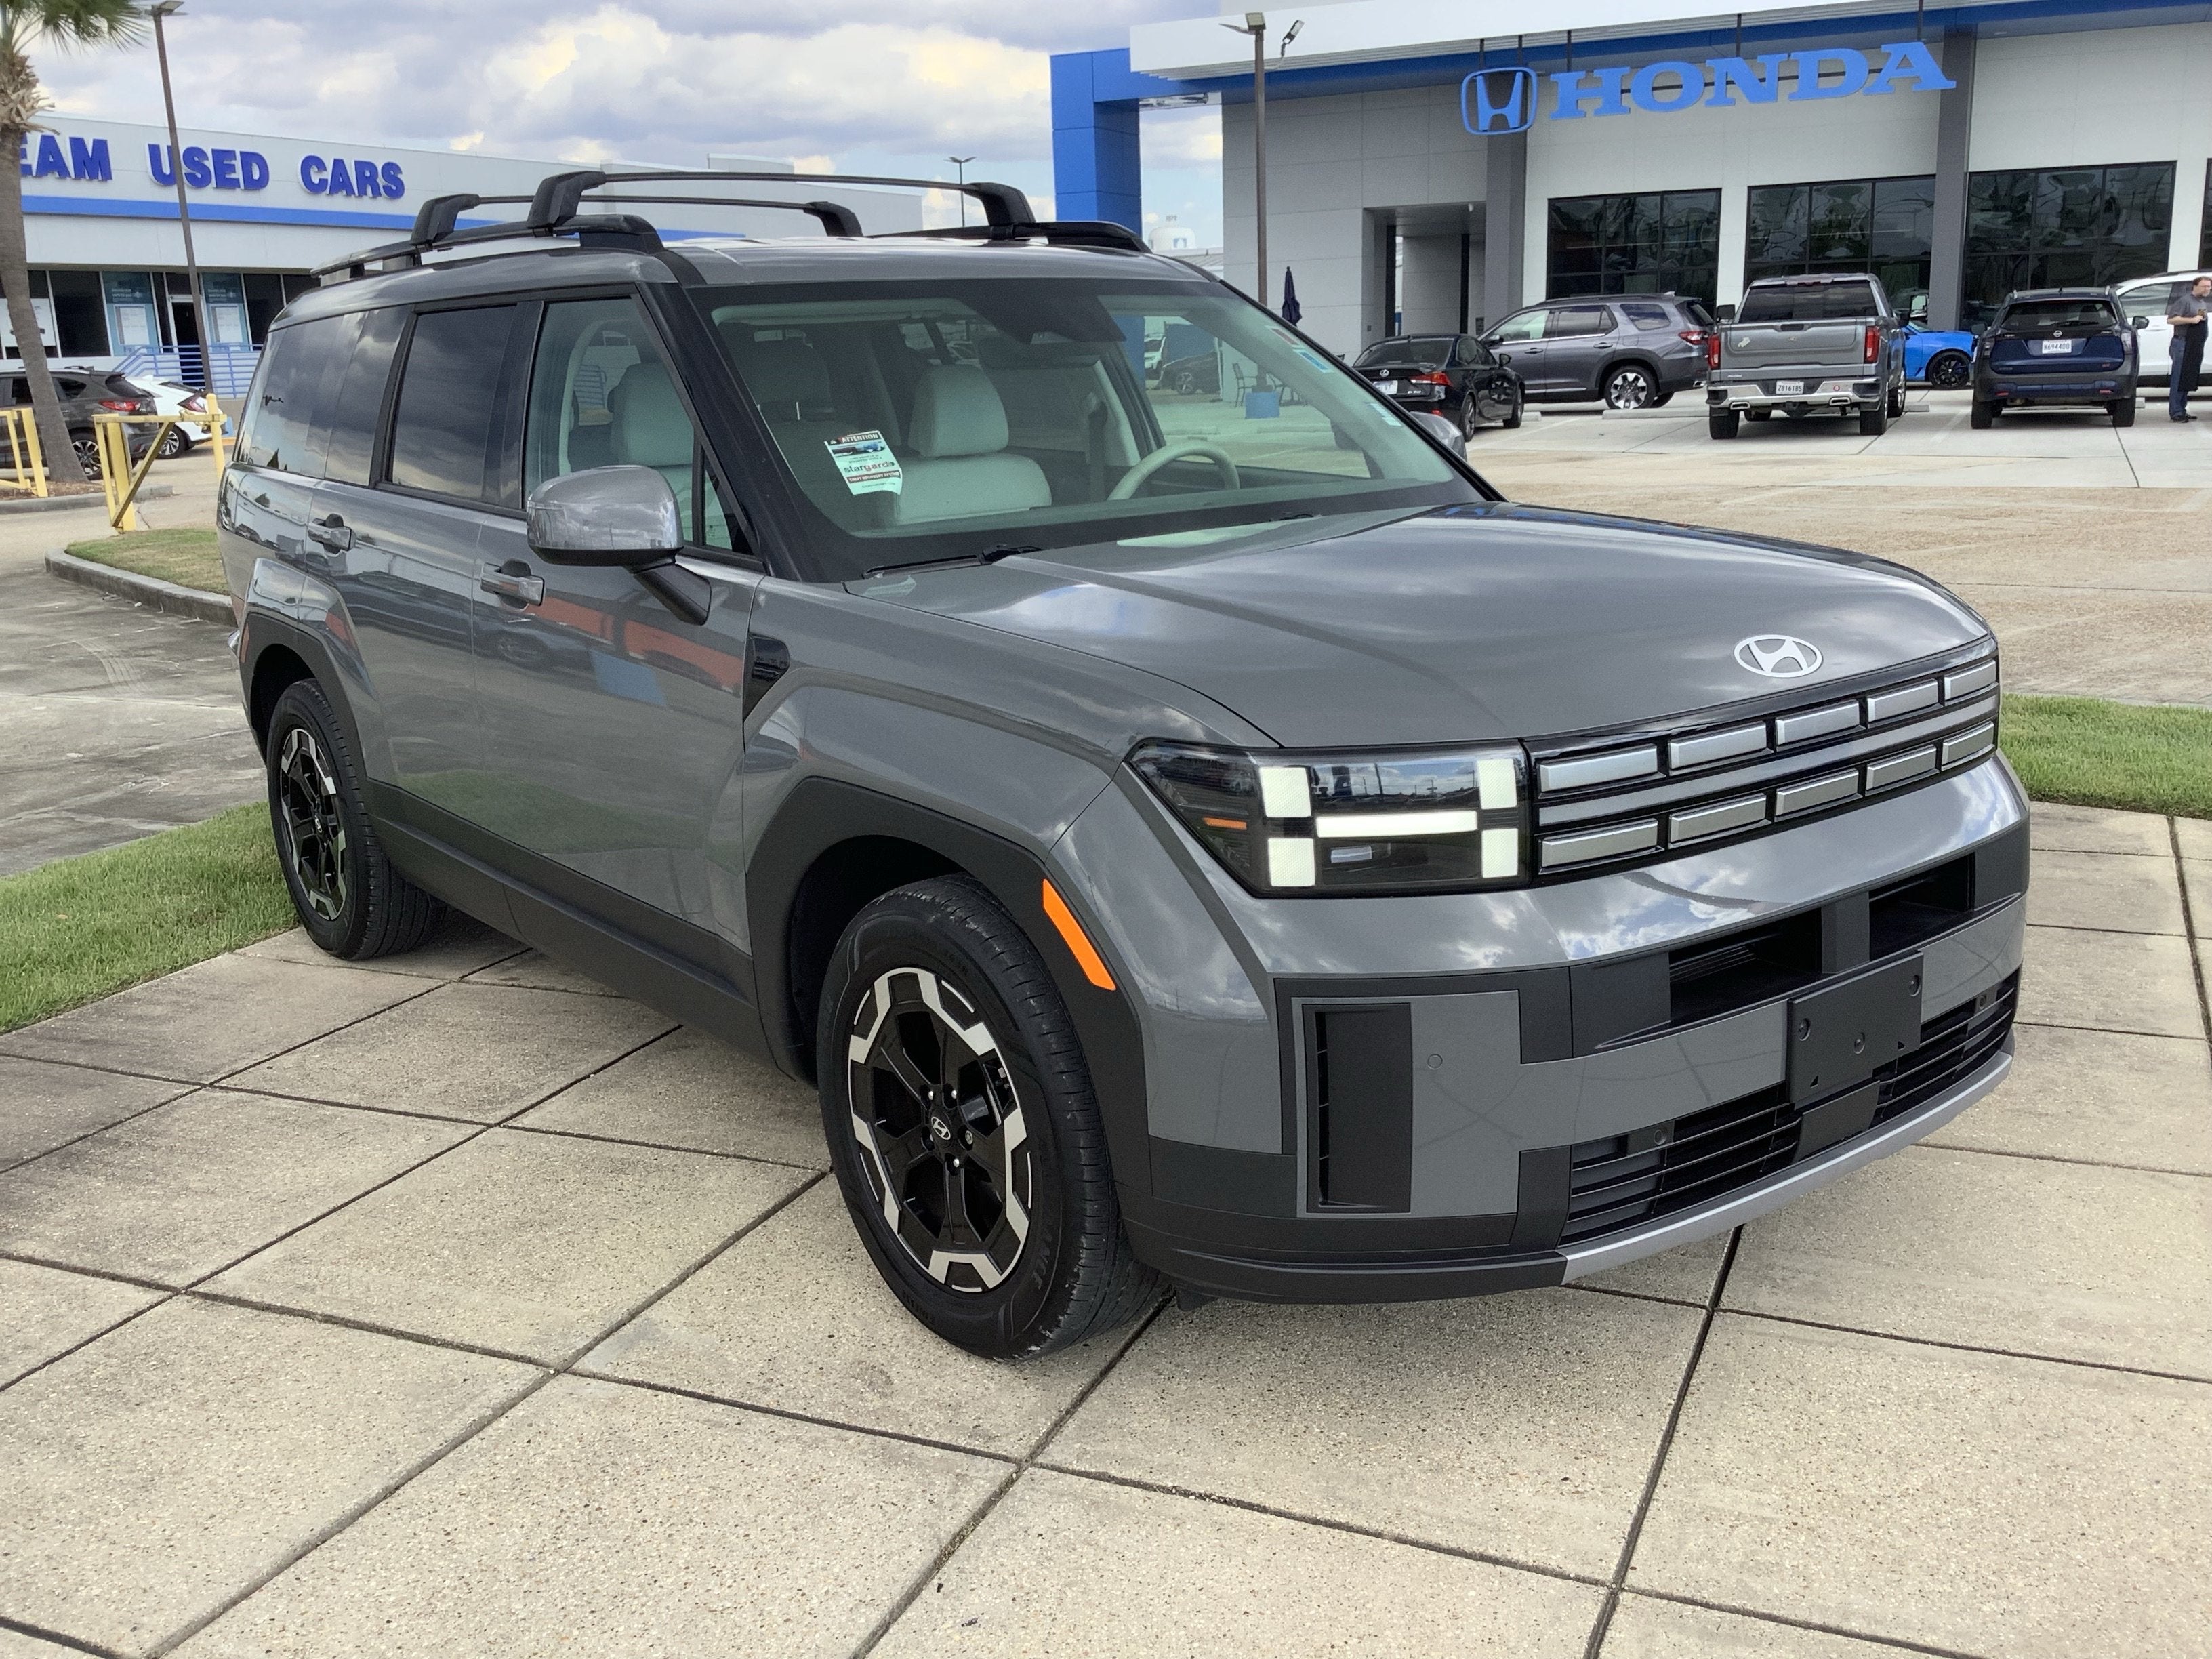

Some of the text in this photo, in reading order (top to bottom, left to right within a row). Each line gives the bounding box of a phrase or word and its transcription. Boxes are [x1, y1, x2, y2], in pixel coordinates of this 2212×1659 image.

[1549, 41, 1957, 120] HONDA
[148, 143, 270, 191] USED
[300, 155, 405, 199] CARS
[842, 434, 878, 443] ATTENTION
[844, 462, 890, 473] stargard
